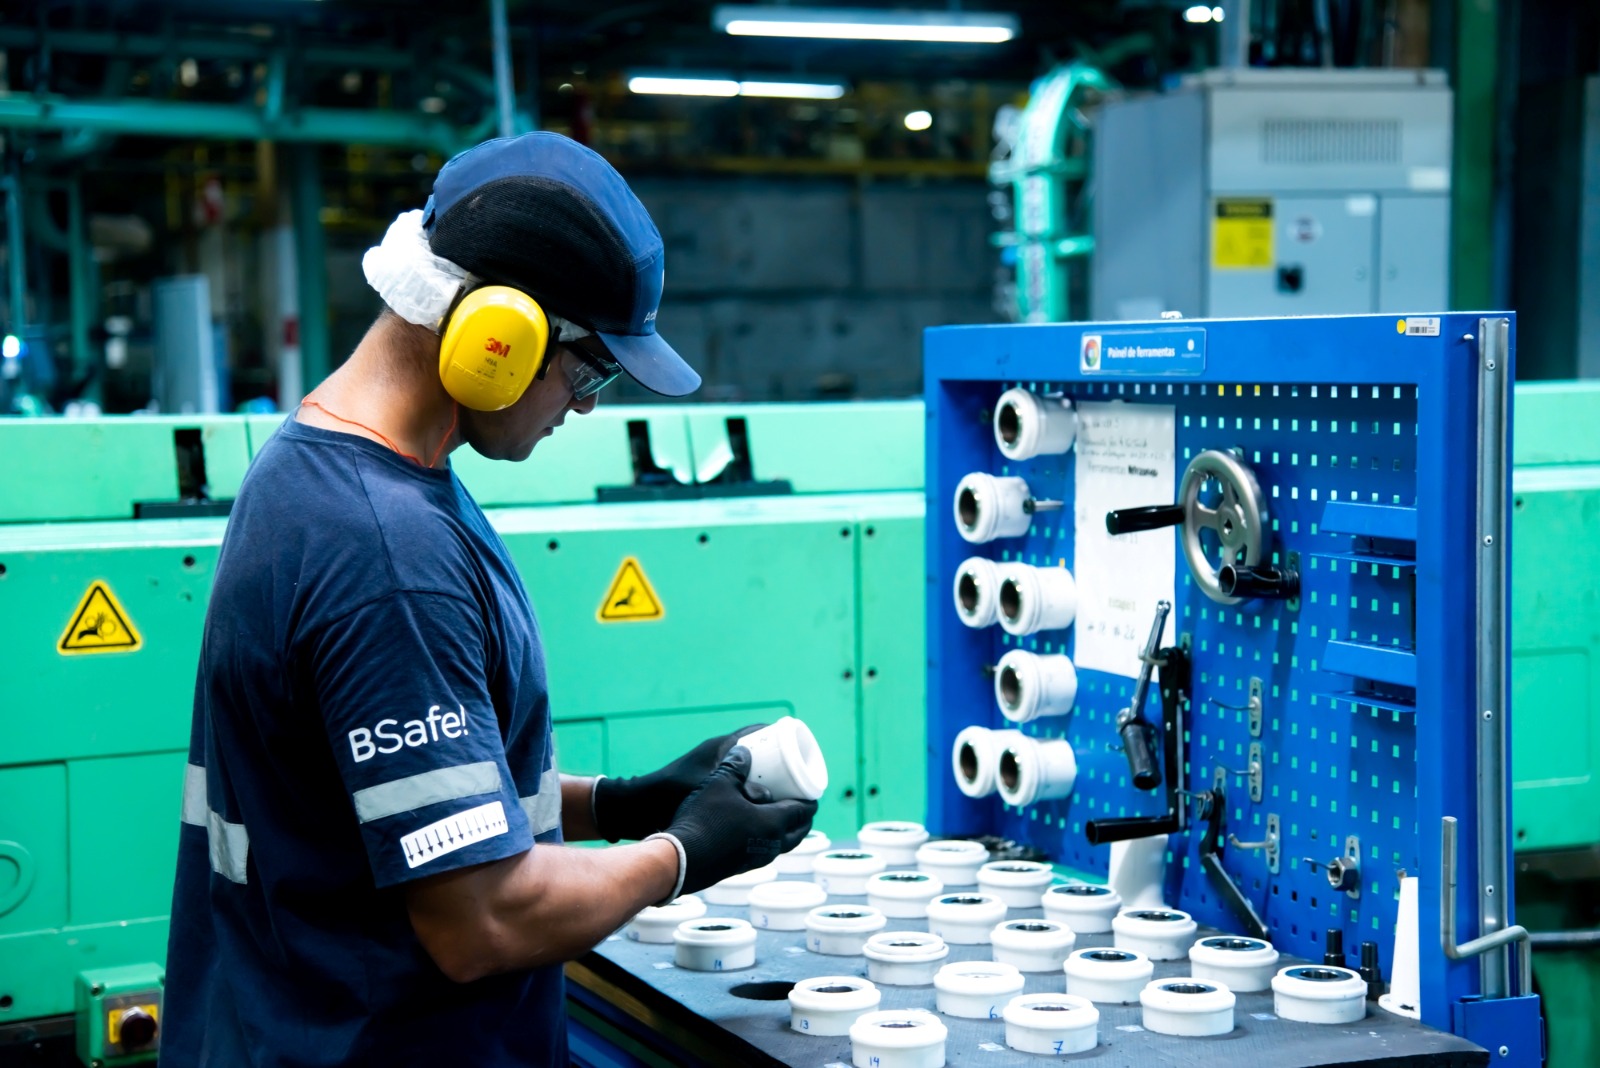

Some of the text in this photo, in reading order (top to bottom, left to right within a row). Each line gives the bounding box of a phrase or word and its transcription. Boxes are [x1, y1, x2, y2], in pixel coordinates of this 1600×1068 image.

[485, 337, 511, 358] 3M
[1107, 347, 1127, 358] Painel
[1128, 346, 1136, 358] de
[1137, 345, 1175, 358] ferramentas
[348, 704, 469, 763] BSafe!
[761, 915, 768, 928] 3
[989, 1005, 998, 1020] 6
[800, 1019, 809, 1030] 13
[1053, 1040, 1063, 1055] 7
[869, 1056, 880, 1067] 14
